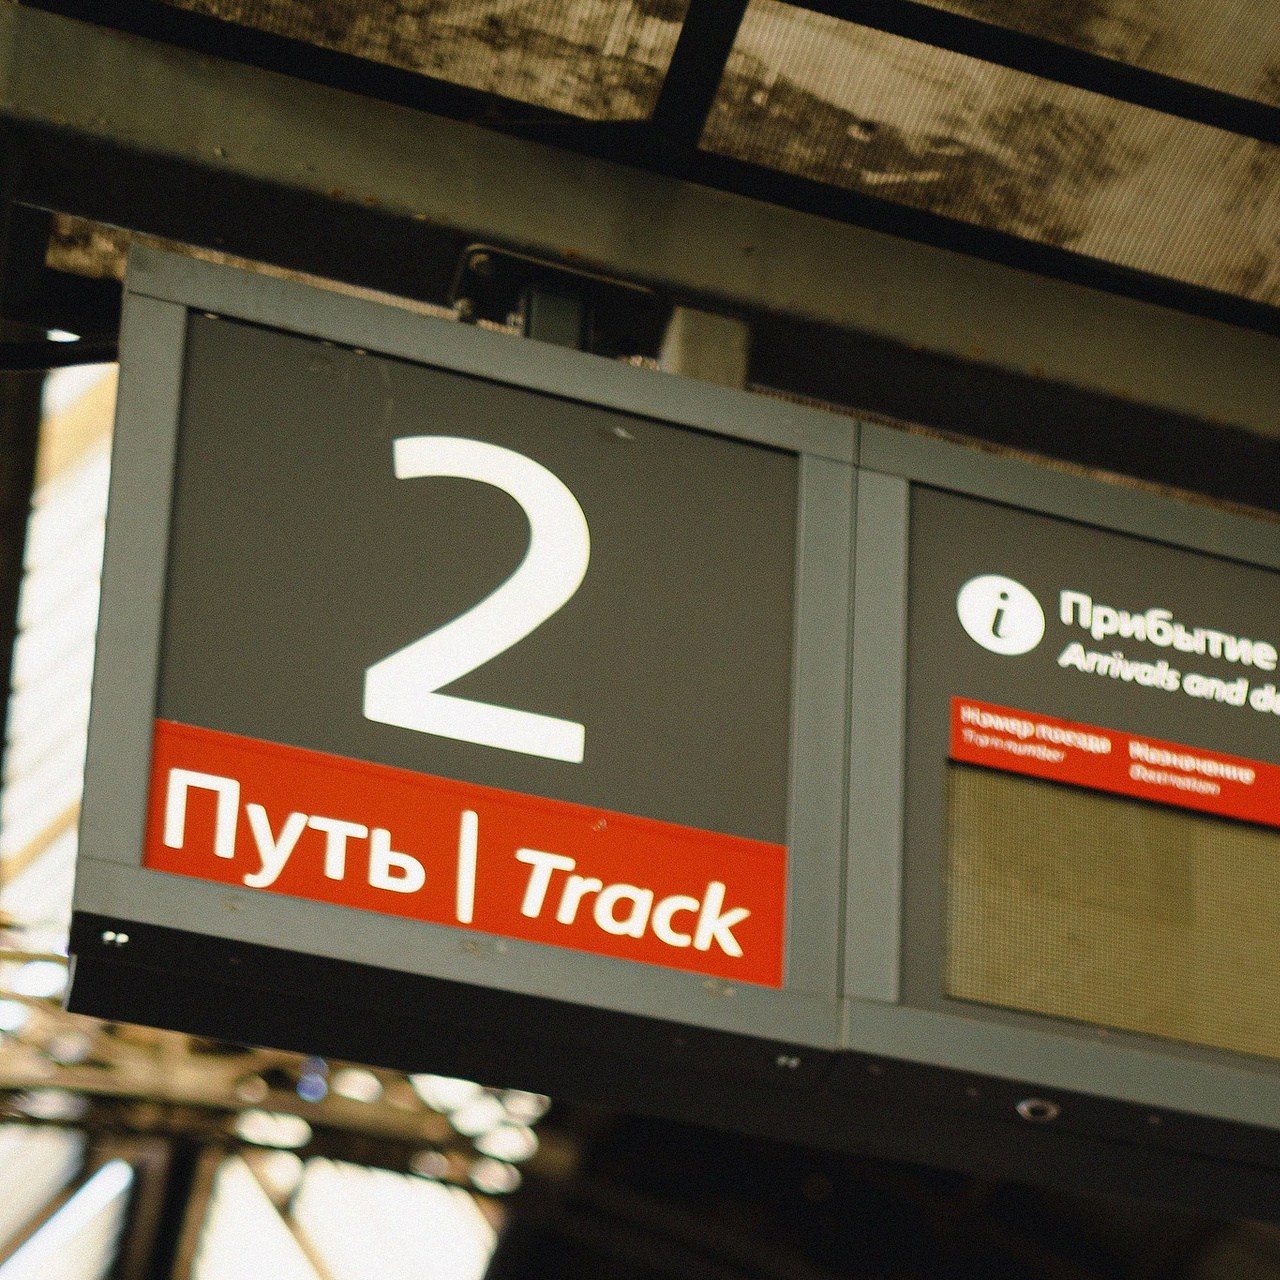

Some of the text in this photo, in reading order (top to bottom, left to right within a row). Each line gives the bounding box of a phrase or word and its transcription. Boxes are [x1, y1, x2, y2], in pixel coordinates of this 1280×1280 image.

[363, 434, 591, 764] 2
[1058, 589, 1278, 672] Прибытие
[1057, 642, 1181, 692] Arrivals
[1181, 672, 1250, 708] and
[162, 767, 752, 957] Путь Track
